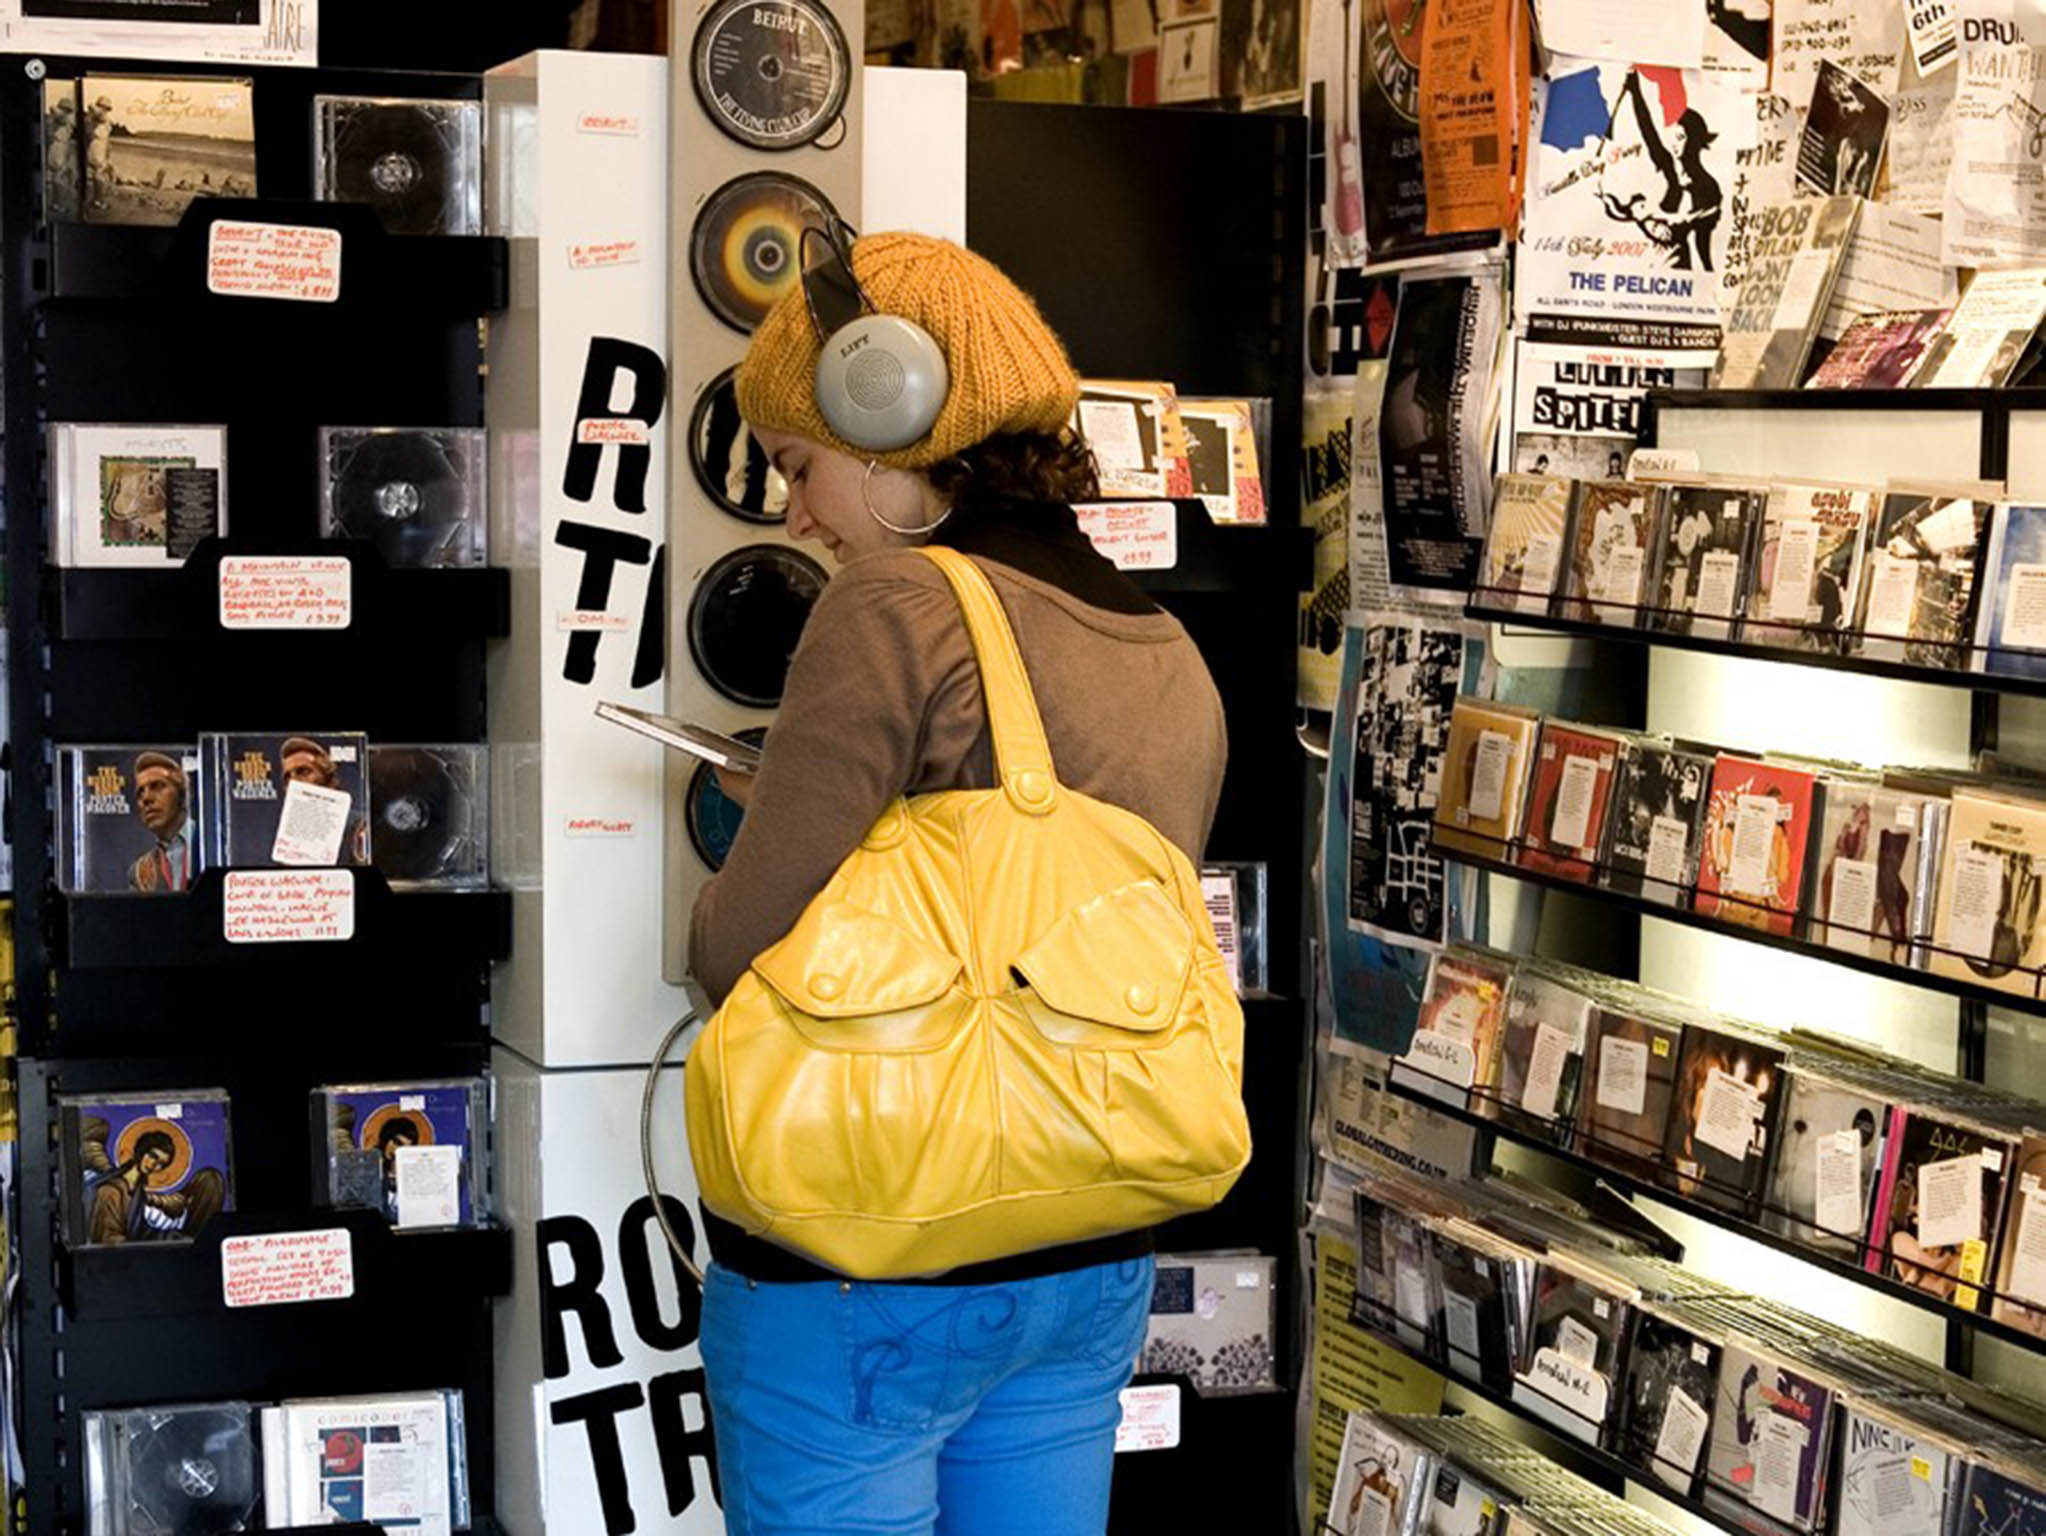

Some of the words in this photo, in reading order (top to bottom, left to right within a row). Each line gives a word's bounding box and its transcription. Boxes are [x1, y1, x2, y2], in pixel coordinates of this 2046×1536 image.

[753, 7, 809, 35] BEIRUT
[1912, 5, 1946, 32] 6th
[1760, 205, 1813, 237] BOB
[1568, 270, 1606, 292] THE
[1613, 272, 1694, 297] PELICAN
